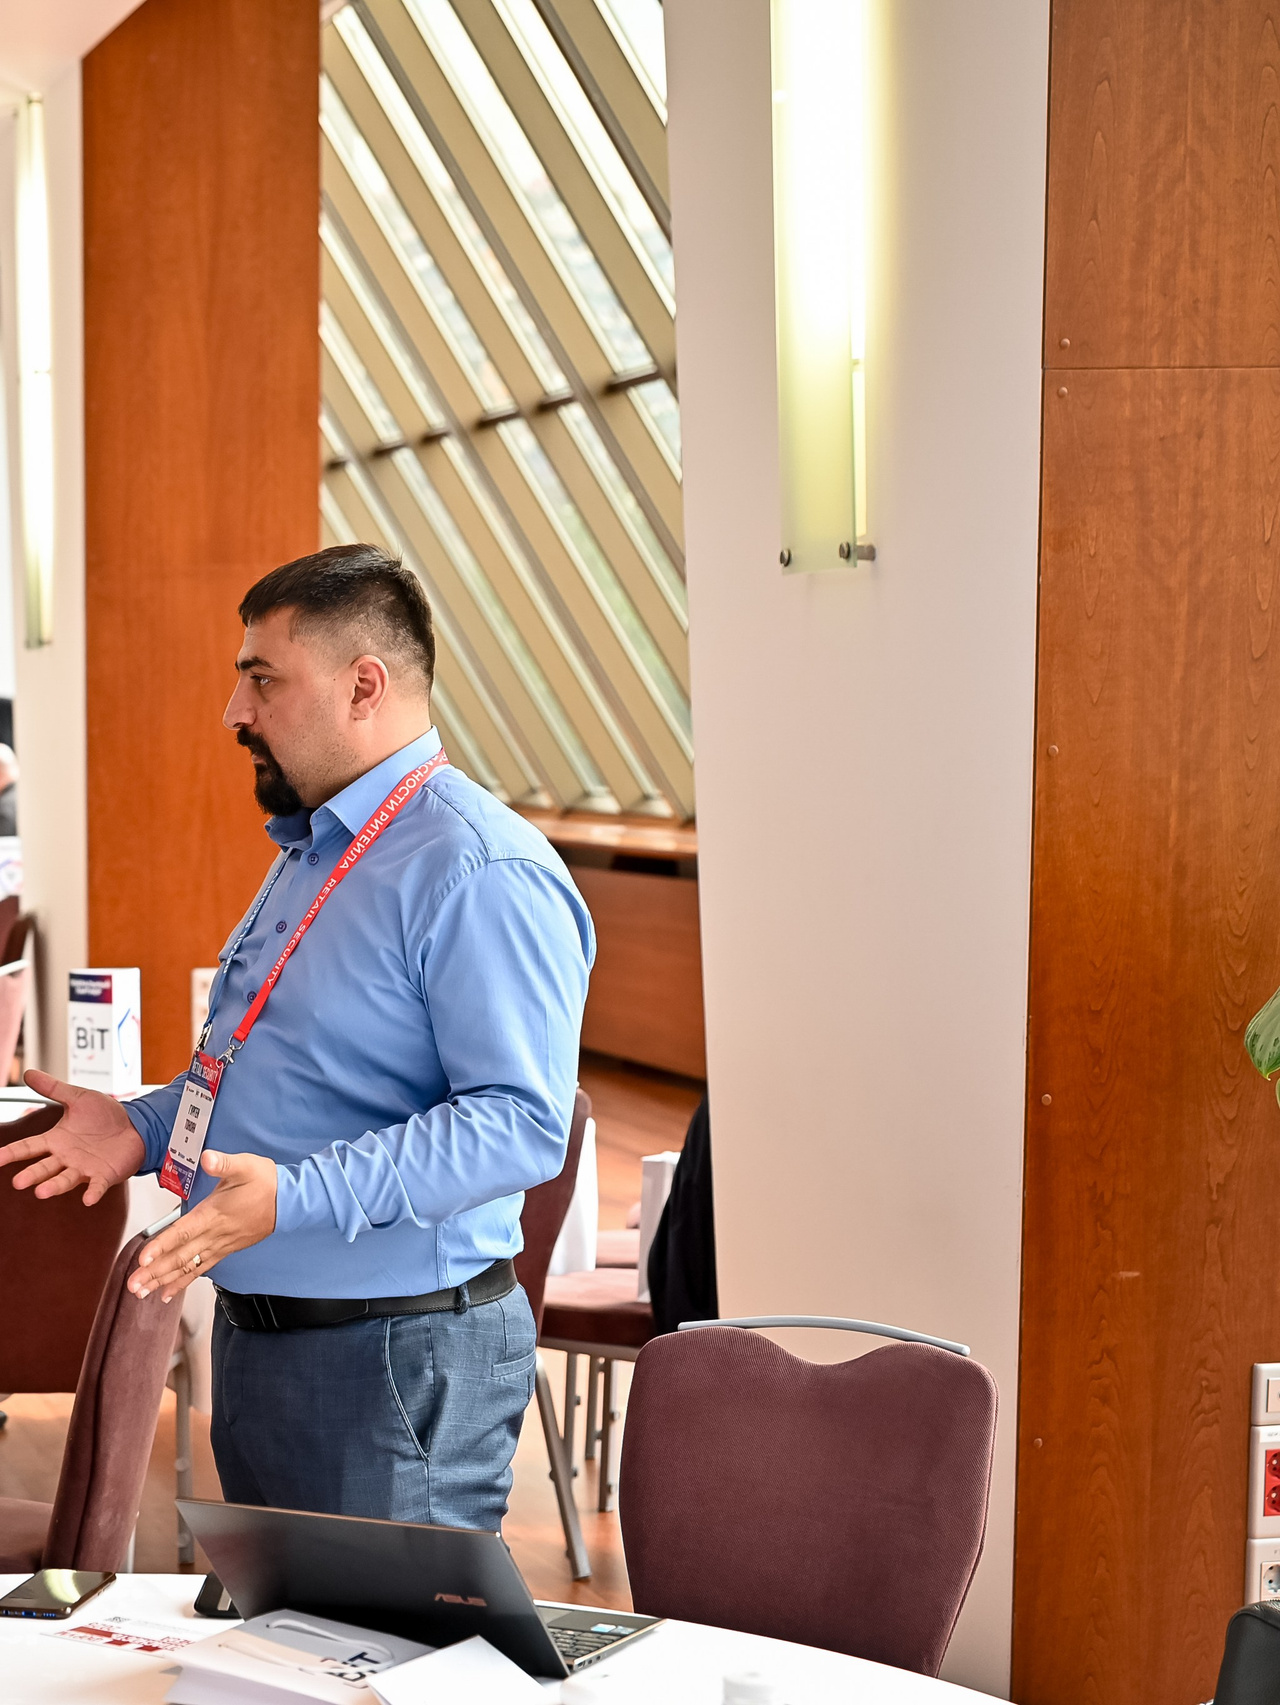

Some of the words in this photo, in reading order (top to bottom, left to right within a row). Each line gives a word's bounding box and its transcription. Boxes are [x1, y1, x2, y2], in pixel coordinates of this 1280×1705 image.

[339, 811, 389, 869] РИТЕЙЛА
[305, 878, 337, 921] RETAIL
[267, 923, 306, 986] SECURITY
[76, 1027, 109, 1050] BiT
